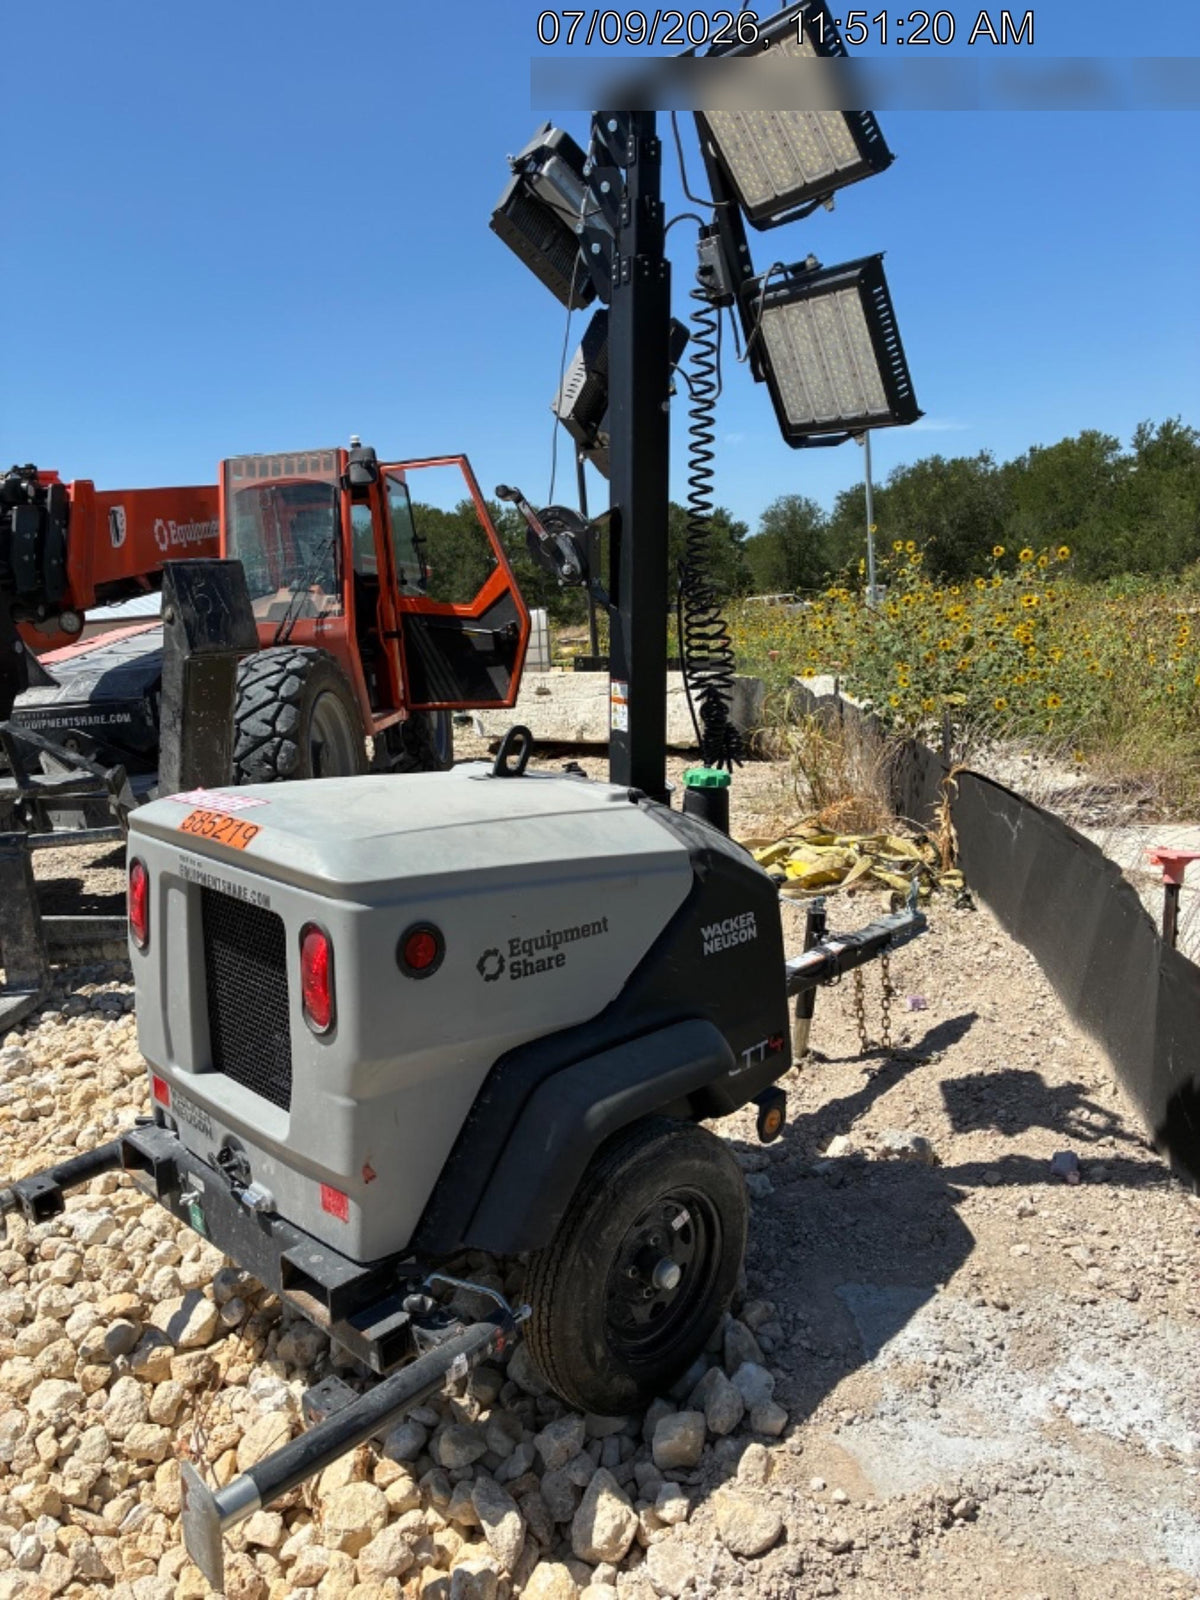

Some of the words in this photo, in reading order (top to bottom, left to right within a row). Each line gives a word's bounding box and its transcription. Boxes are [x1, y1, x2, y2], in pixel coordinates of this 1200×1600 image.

[20, 713, 131, 729] QUIPMENTSHARE.COM
[508, 916, 608, 957] Equipment
[700, 911, 756, 941] WACKER
[703, 924, 758, 956] NEUSON
[509, 952, 566, 980] Share
